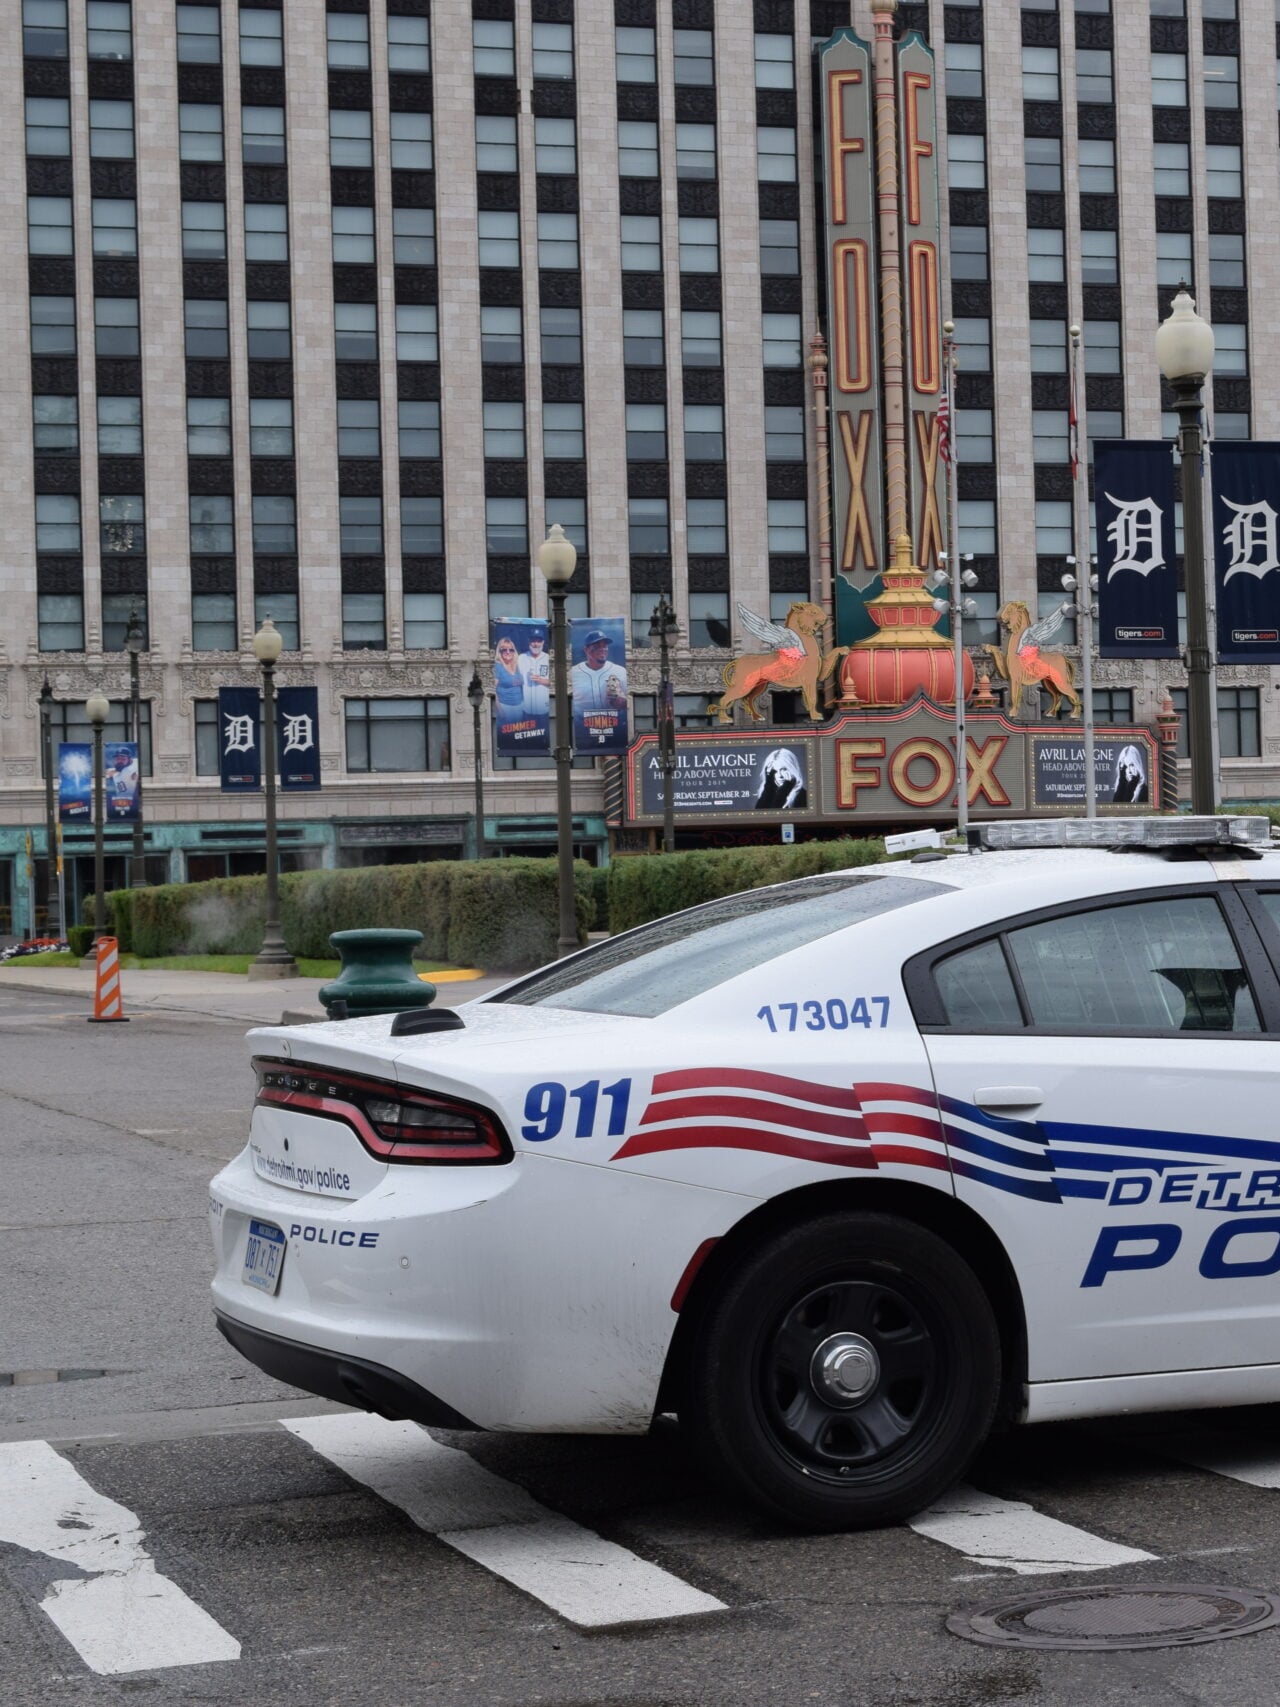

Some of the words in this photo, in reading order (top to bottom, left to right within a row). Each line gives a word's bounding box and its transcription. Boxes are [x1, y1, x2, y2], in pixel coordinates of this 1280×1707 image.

[828, 69, 878, 571] FOX
[904, 70, 946, 571] FOX
[1104, 491, 1166, 584] D
[1220, 495, 1280, 586] D
[1118, 630, 1162, 639] tigers.com
[1234, 632, 1276, 640] tigers.com
[501, 720, 537, 734] SUMMER
[583, 715, 618, 729] SUMMER
[514, 729, 545, 740] GETAWAY
[648, 756, 690, 769] AIL
[695, 753, 757, 768] LAVIGNE
[1039, 748, 1068, 760] AVRIL
[1071, 748, 1114, 761] LAGNE
[654, 770, 682, 779] HD
[684, 769, 716, 779] ABOVE
[719, 768, 752, 778] WATER
[835, 736, 1011, 809] FOX
[1042, 762, 1062, 772] HEAD
[1064, 762, 1086, 772] ABOVE
[1091, 762, 1111, 772] ATER
[698, 790, 739, 799] SEPTEMBER
[741, 790, 750, 798] 28
[757, 996, 890, 1033] 173047
[521, 1077, 632, 1142] 911
[290, 1223, 380, 1249] POLICE
